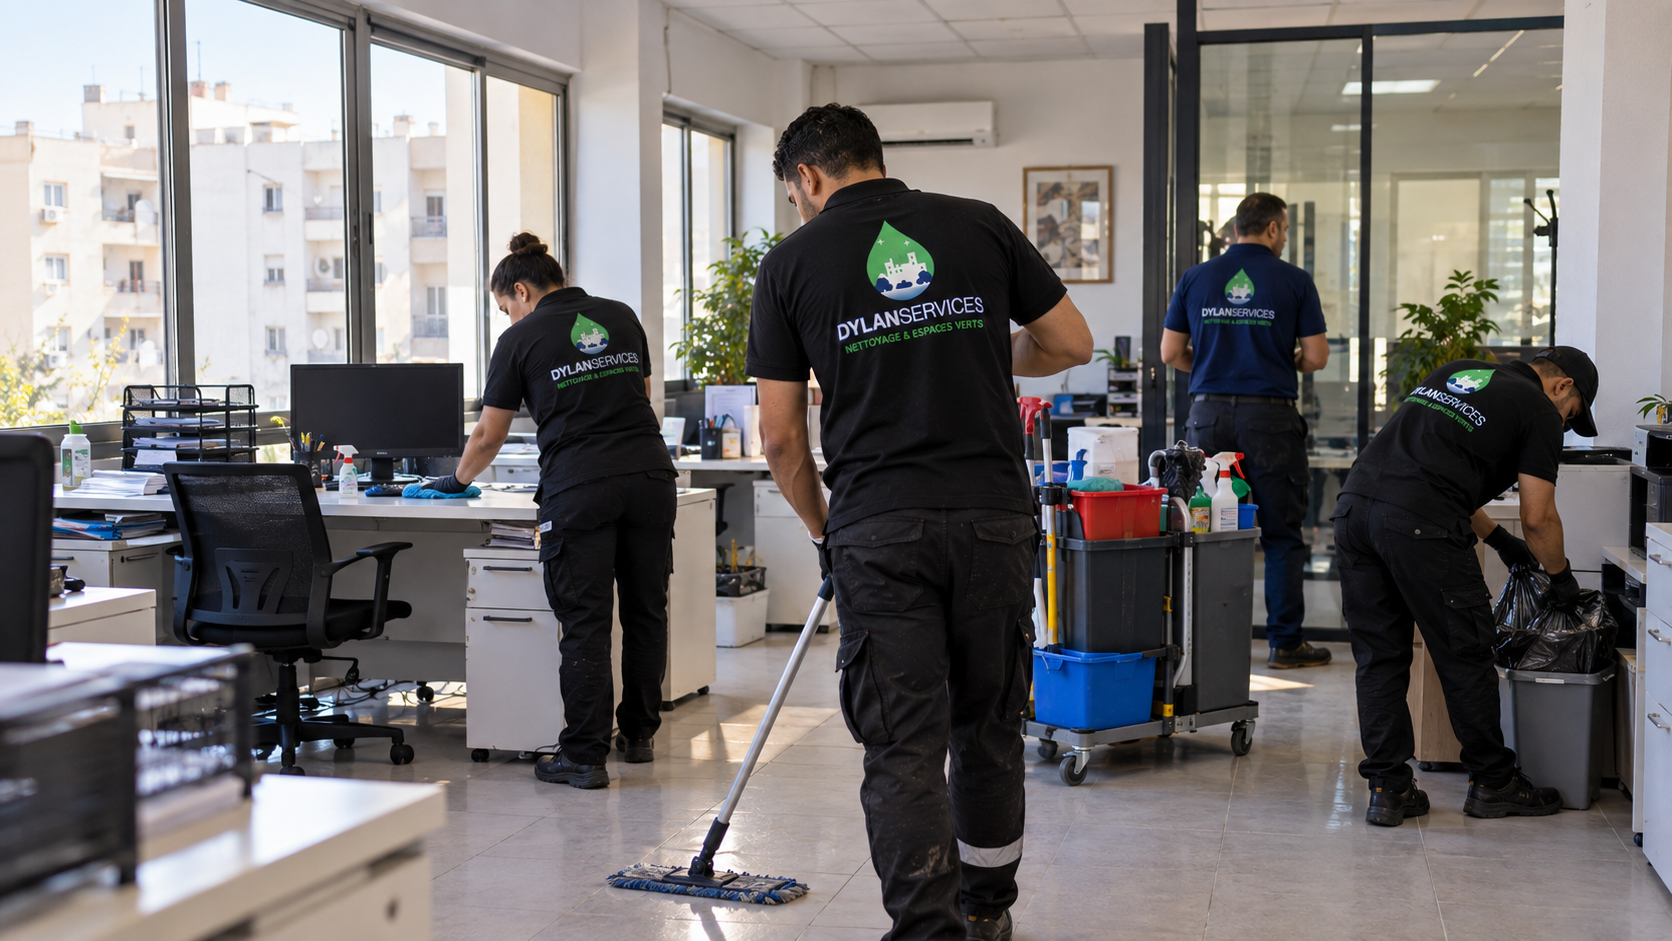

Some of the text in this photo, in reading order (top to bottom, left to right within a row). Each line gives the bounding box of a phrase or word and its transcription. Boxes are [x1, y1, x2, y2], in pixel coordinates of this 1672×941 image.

[837, 297, 984, 341] DYLANSERVICES
[1202, 307, 1275, 319] DYLANSERVICES
[845, 319, 984, 354] NETTOYAGE & ESPACES VERTS
[550, 352, 639, 381] DYLANSERVICES
